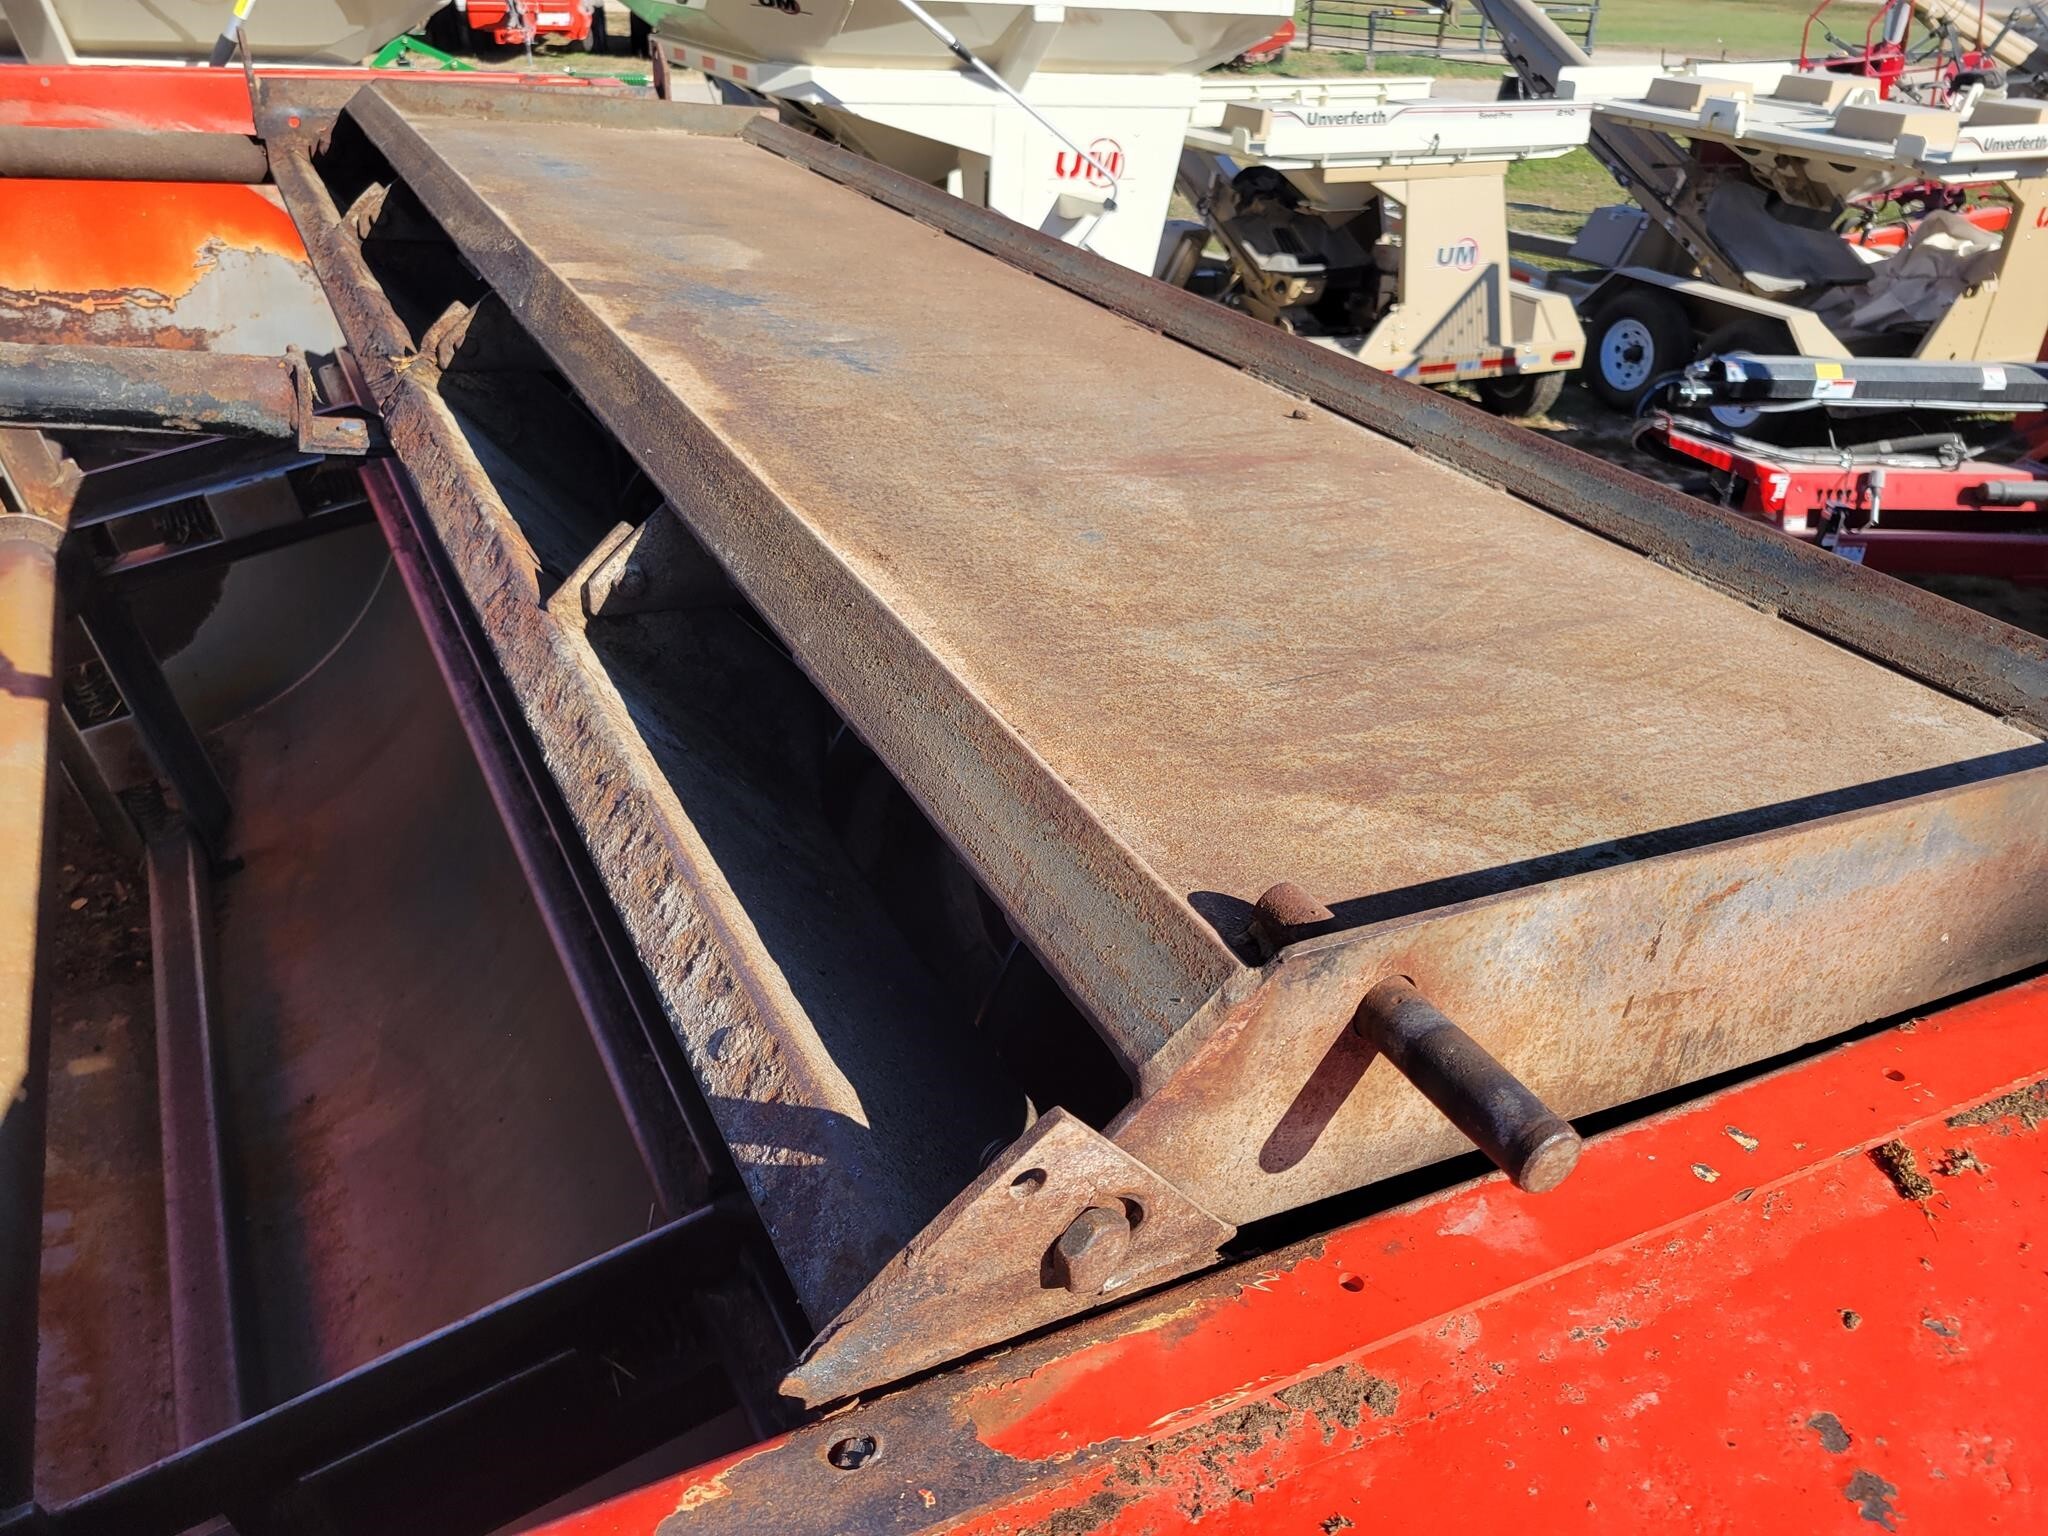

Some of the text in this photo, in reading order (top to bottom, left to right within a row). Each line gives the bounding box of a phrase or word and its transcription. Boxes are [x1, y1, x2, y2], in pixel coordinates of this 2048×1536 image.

[1307, 111, 1386, 126] Unverferth
[1983, 135, 2048, 151] Unverferth
[1056, 150, 1120, 179] UM
[1437, 245, 1478, 266] UM
